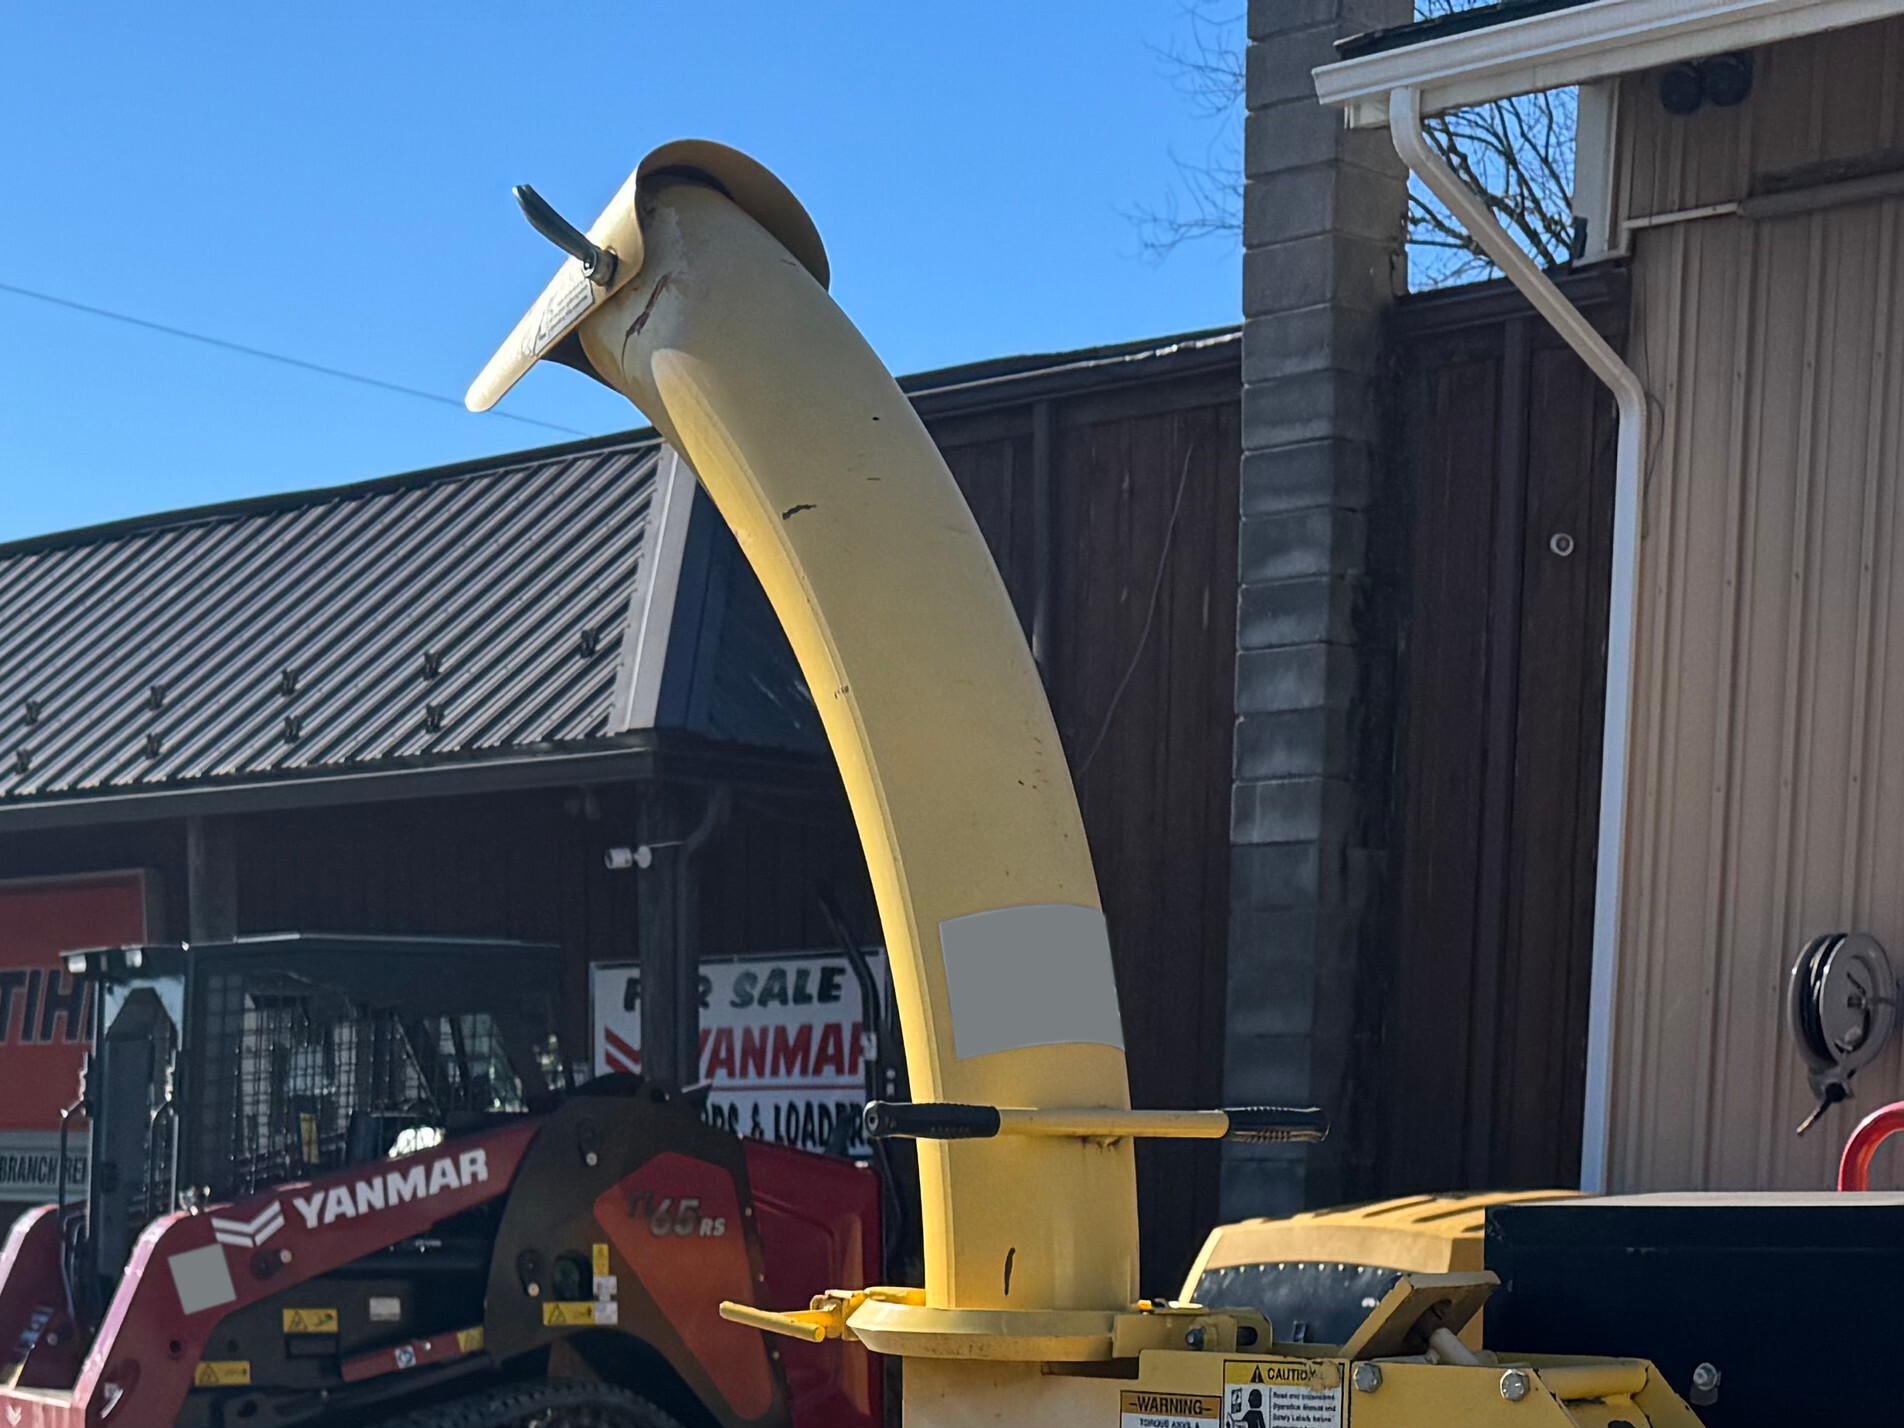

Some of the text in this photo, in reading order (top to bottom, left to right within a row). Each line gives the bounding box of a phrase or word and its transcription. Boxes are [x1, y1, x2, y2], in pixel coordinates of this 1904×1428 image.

[623, 966, 847, 1011] FR SALE
[773, 1099, 866, 1148] LOADR
[292, 1147, 489, 1230] YANMAR
